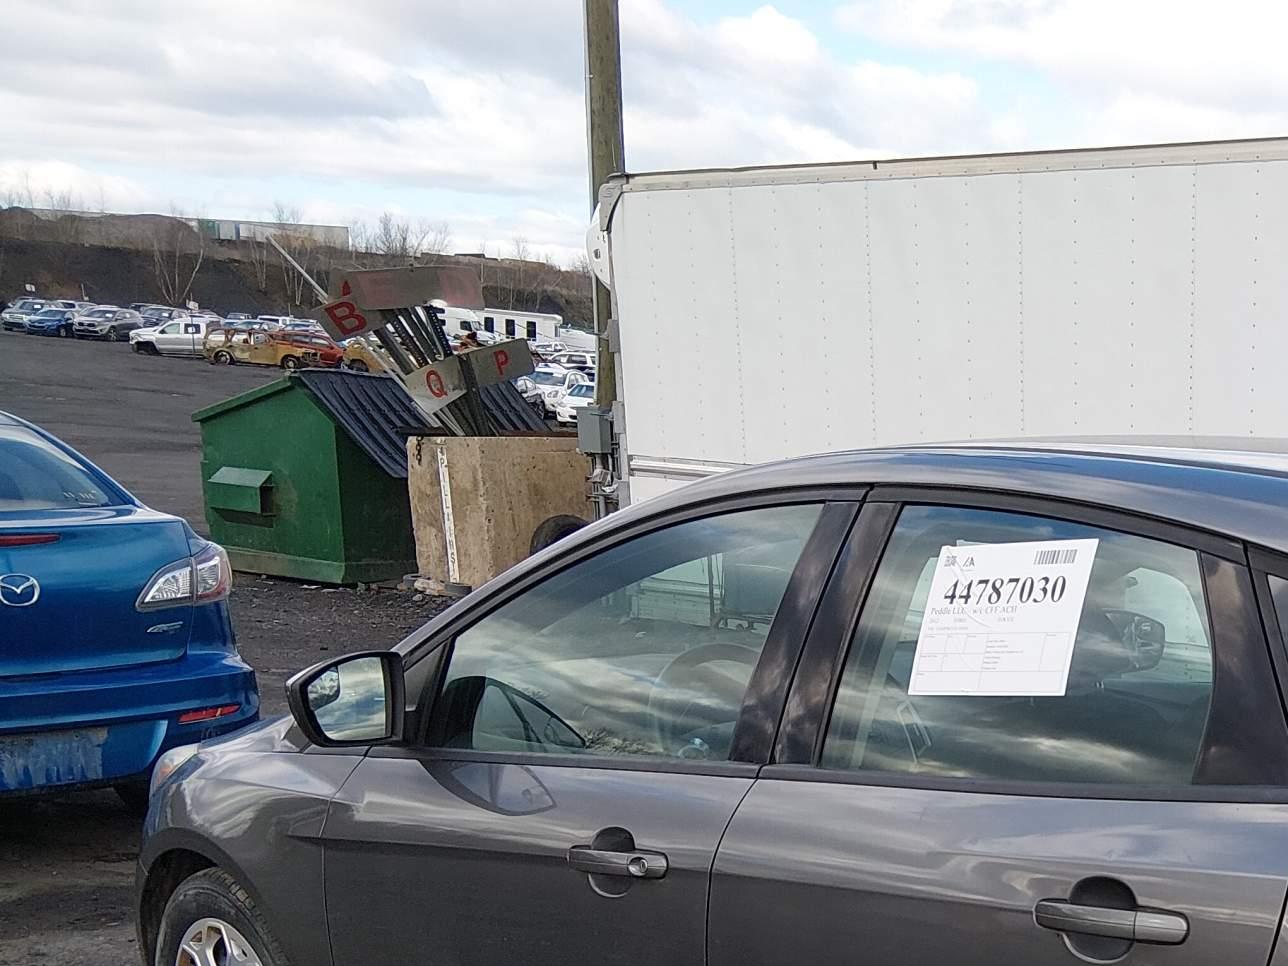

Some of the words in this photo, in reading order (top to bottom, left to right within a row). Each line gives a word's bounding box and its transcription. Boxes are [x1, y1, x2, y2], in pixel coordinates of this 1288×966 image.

[324, 301, 367, 336] B
[493, 349, 509, 376] P
[426, 369, 448, 400] Q
[943, 575, 1067, 605] 44787030
